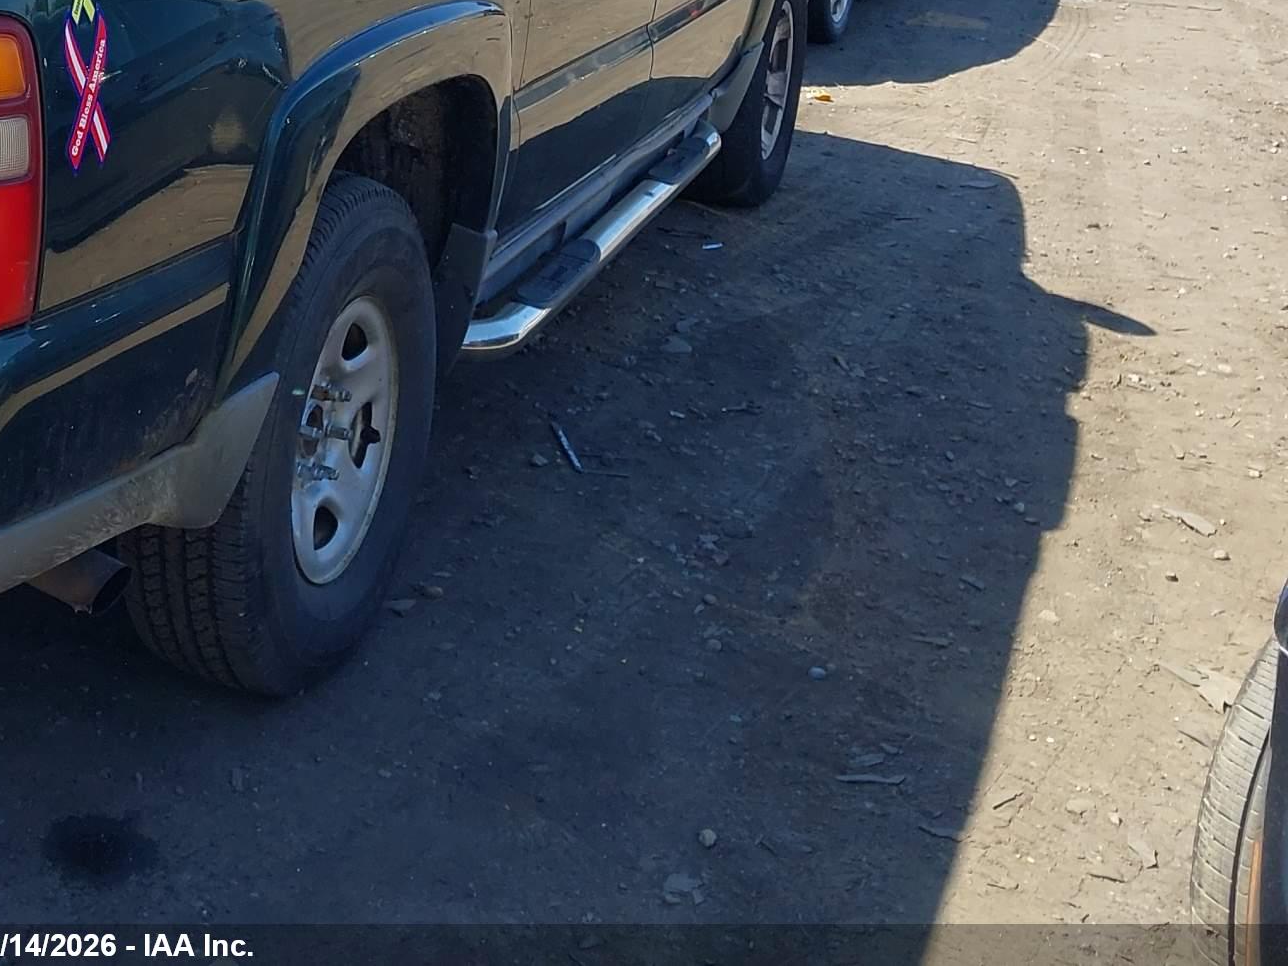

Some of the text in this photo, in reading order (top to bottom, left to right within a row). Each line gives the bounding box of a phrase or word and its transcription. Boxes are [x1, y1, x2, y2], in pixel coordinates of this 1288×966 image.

[72, 39, 106, 157] God Bless America
